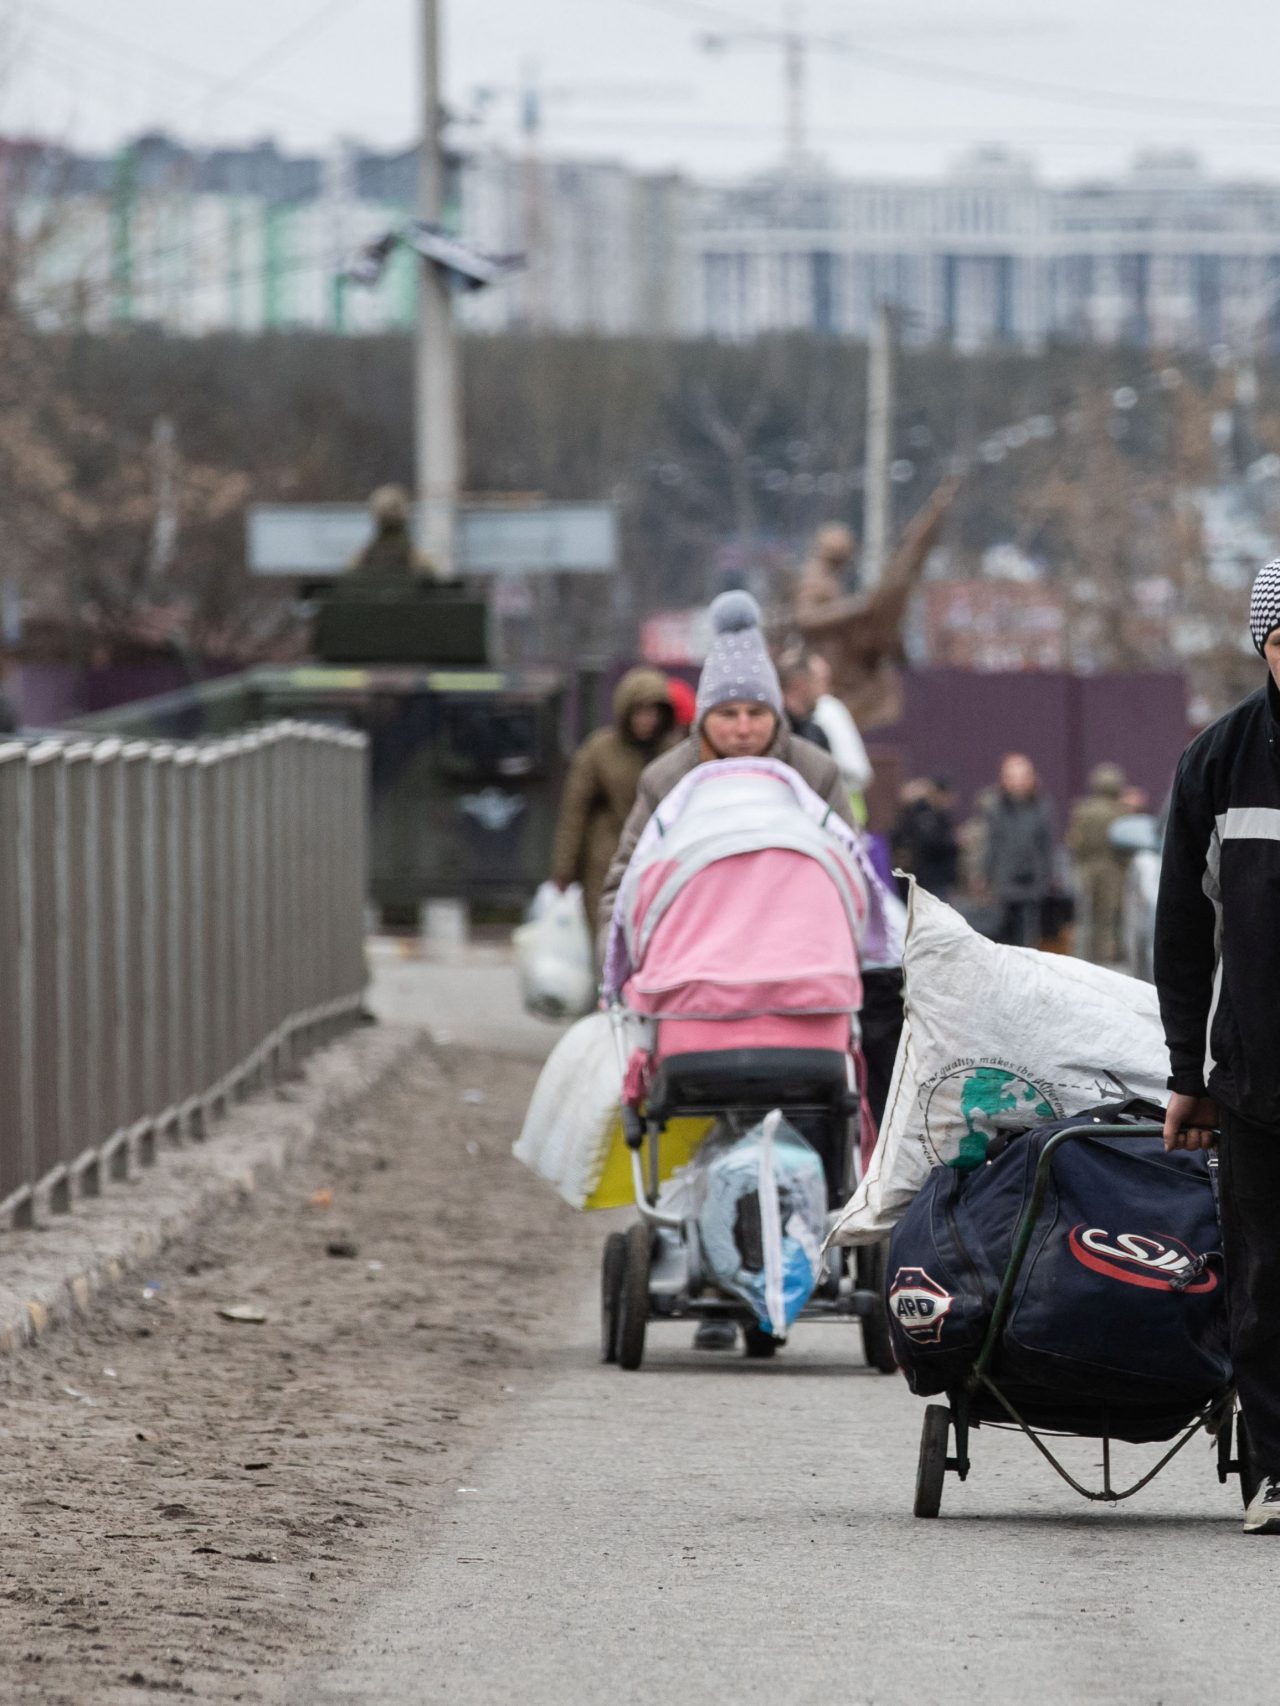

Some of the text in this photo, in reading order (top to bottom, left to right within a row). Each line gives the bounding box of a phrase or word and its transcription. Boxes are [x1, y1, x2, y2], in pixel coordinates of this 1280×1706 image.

[940, 1057, 975, 1078] quality
[980, 1056, 1015, 1069] makes
[1017, 1065, 1034, 1078] the
